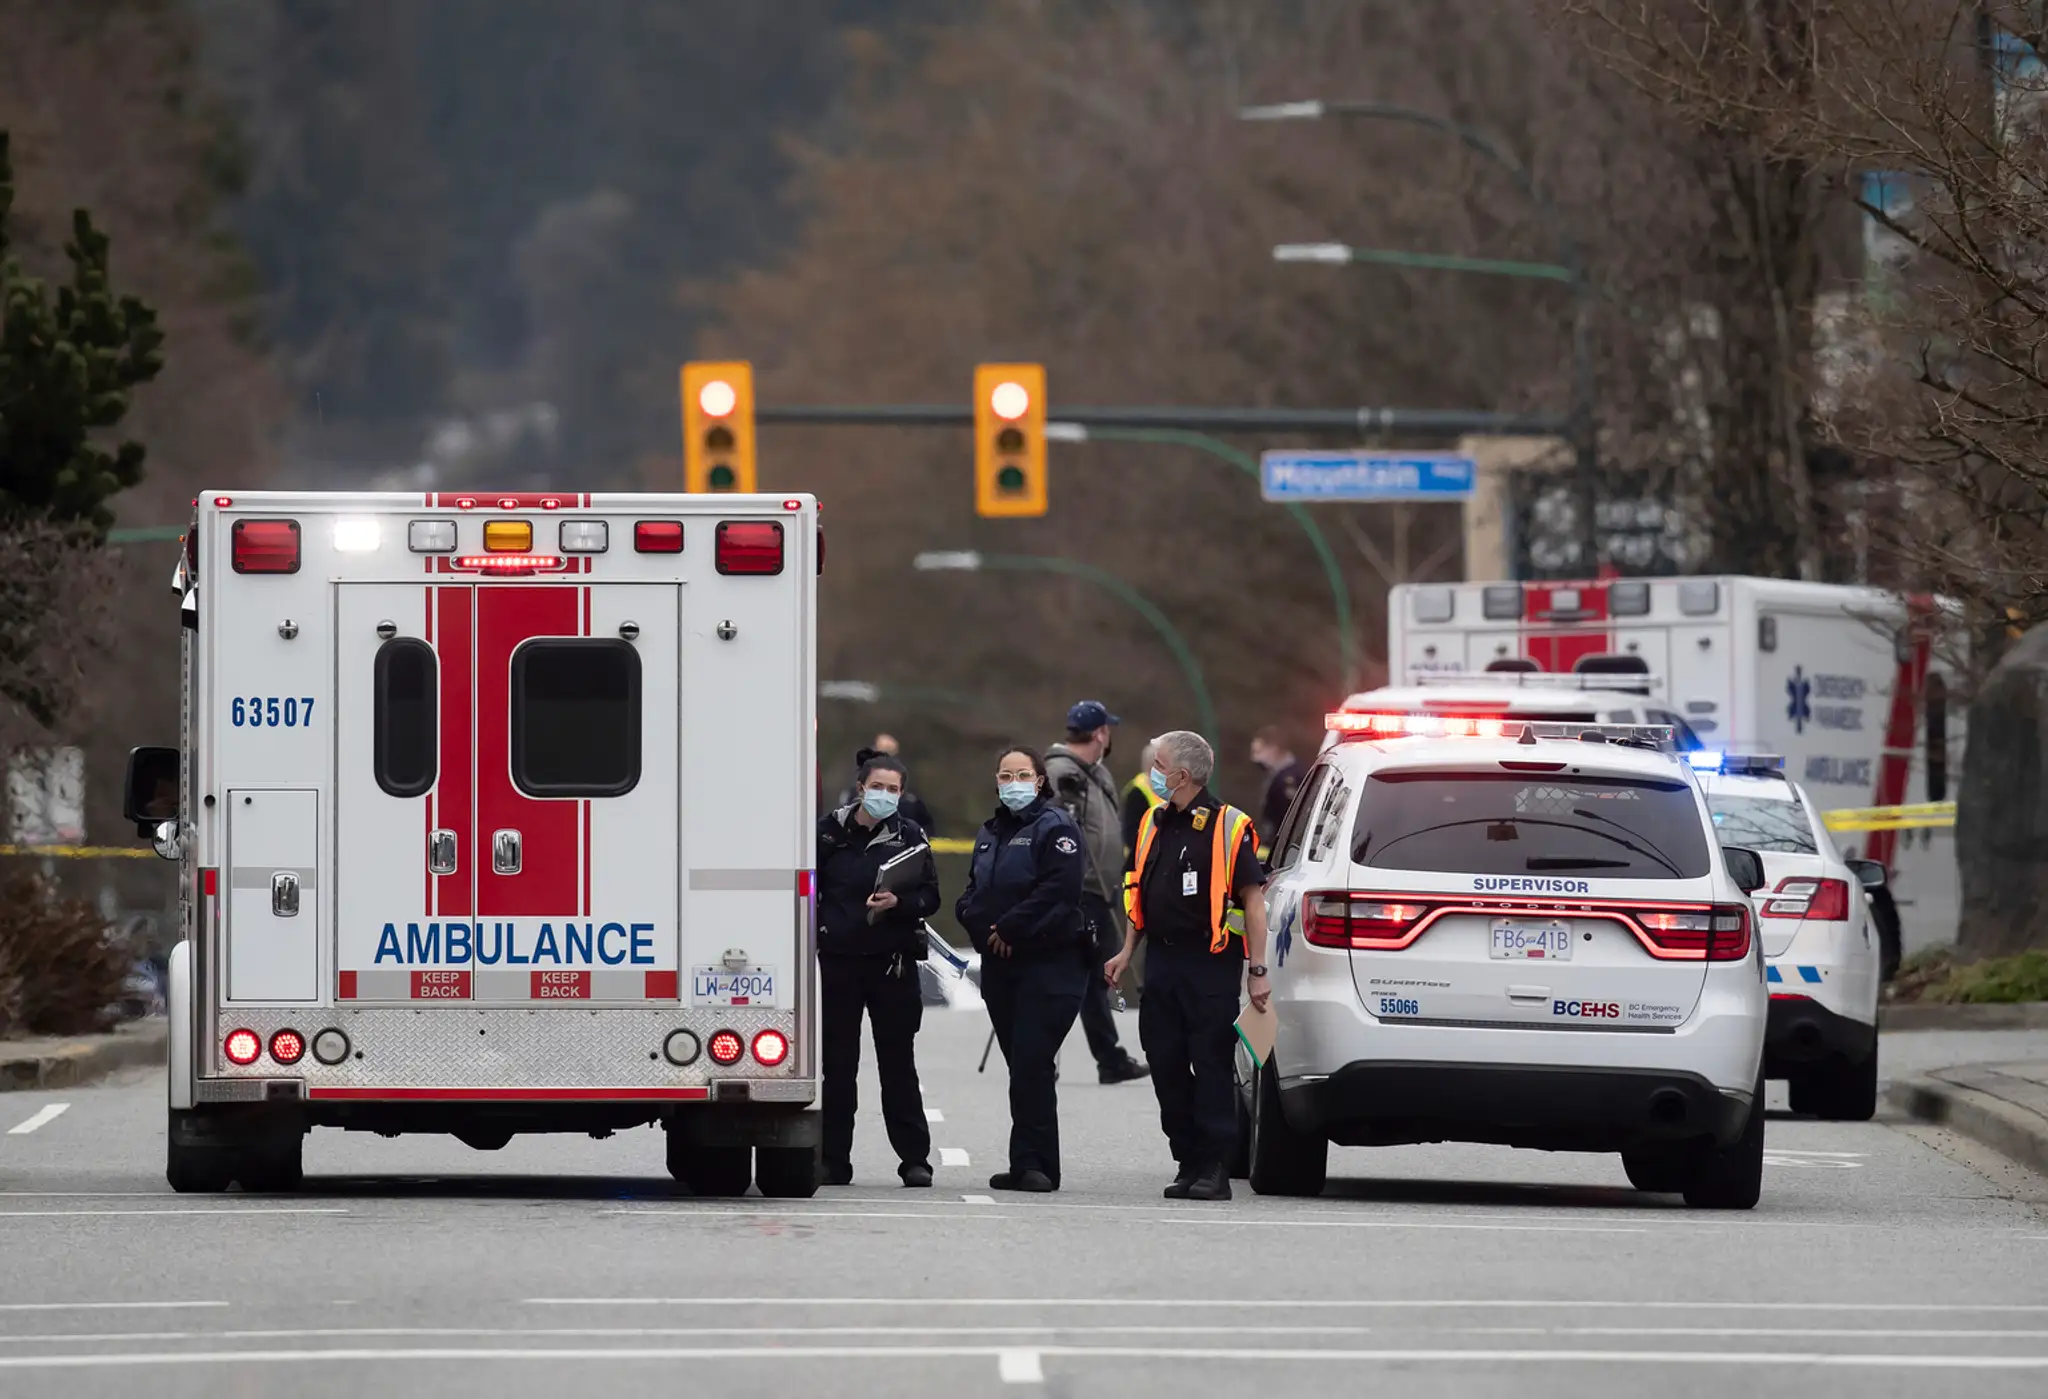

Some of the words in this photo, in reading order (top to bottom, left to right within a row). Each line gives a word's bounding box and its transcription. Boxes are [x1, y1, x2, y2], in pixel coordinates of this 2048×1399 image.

[231, 696, 315, 728] 63507
[1473, 878, 1589, 893] SUPERVISOR
[373, 922, 656, 965] AMBULANCE
[421, 972, 460, 984] KEEP
[541, 972, 580, 984] KEEP
[420, 986, 460, 997] BACK
[540, 986, 580, 997] BACK
[1380, 998, 1419, 1015] 55066
[1553, 1000, 1620, 1018] BCEHS
[1628, 1003, 1640, 1011] BC
[1641, 1003, 1680, 1013] Emergency
[1627, 1012, 1651, 1020] Health
[1652, 1012, 1683, 1021] Services
